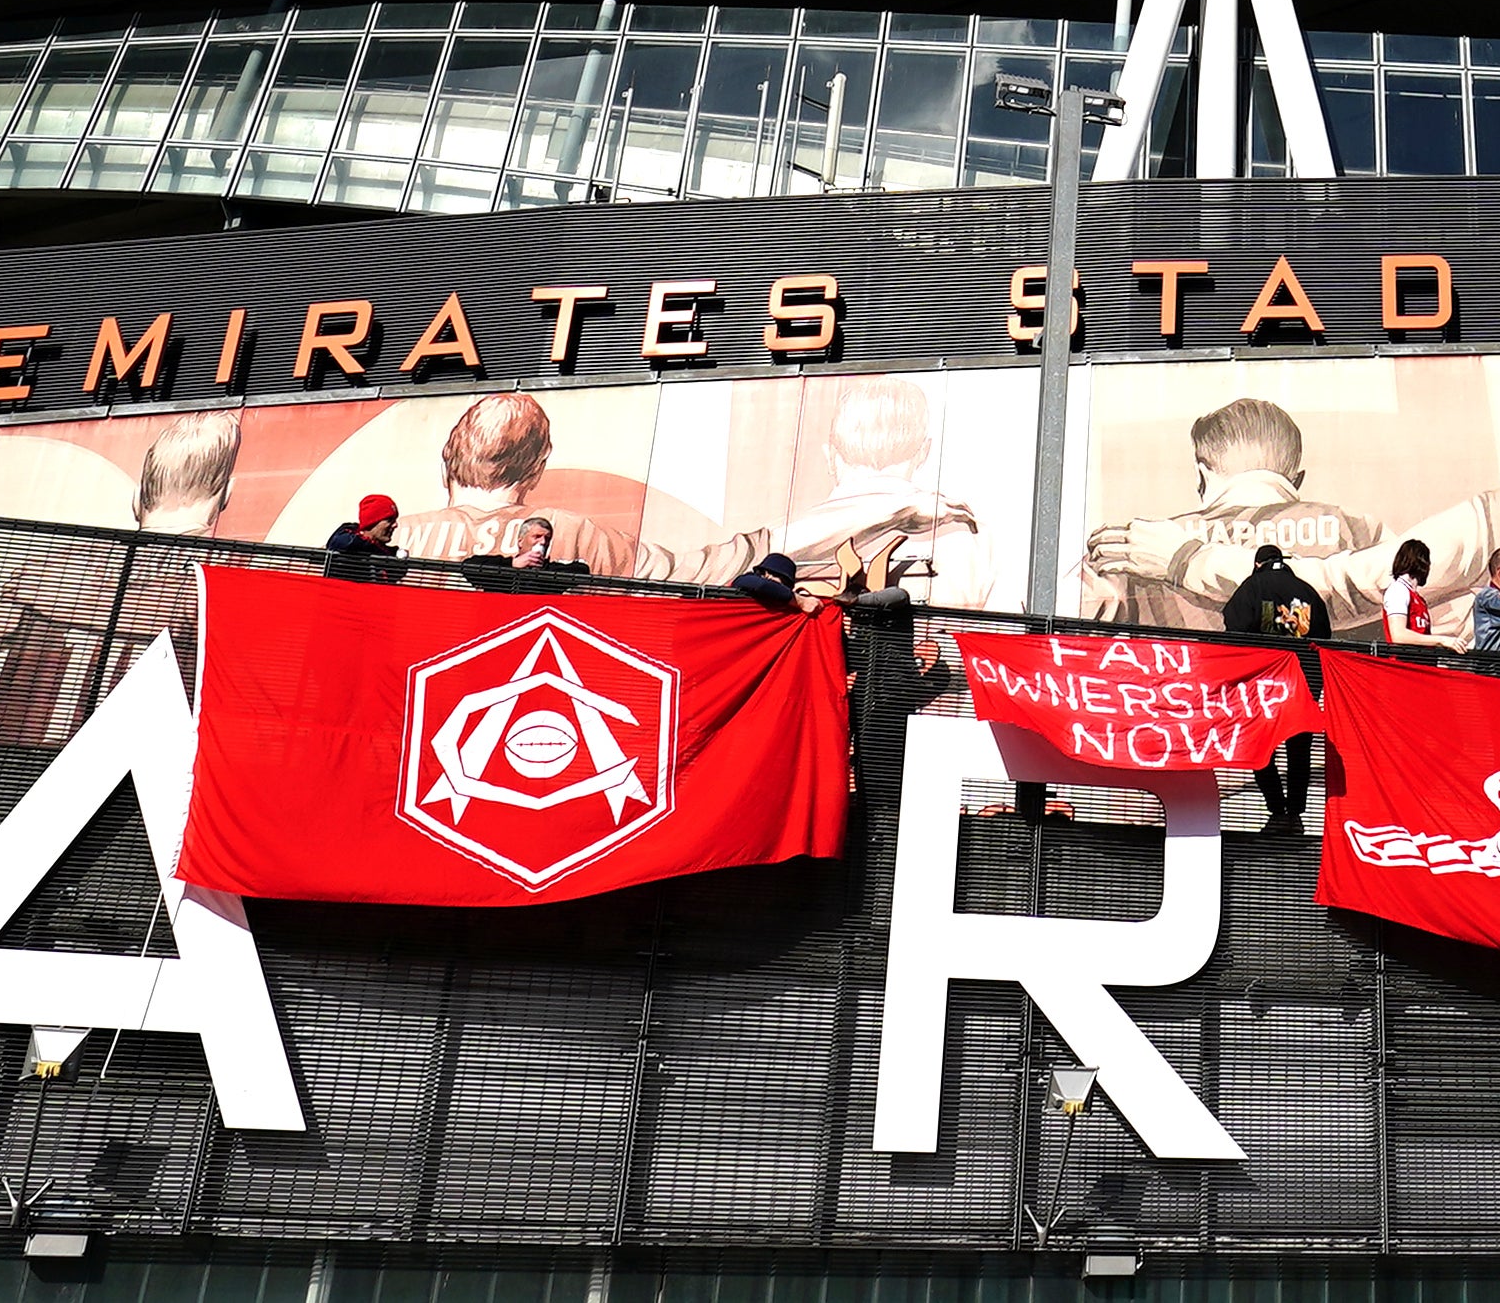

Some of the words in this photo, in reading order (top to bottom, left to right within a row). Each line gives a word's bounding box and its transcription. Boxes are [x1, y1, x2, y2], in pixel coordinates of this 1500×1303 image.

[400, 517, 556, 558] WILSO
[1185, 514, 1340, 549] HAPGOOD
[1048, 637, 1192, 676] FAN
[970, 656, 1290, 720] OWNERSHIP
[1071, 721, 1243, 768] NOW
